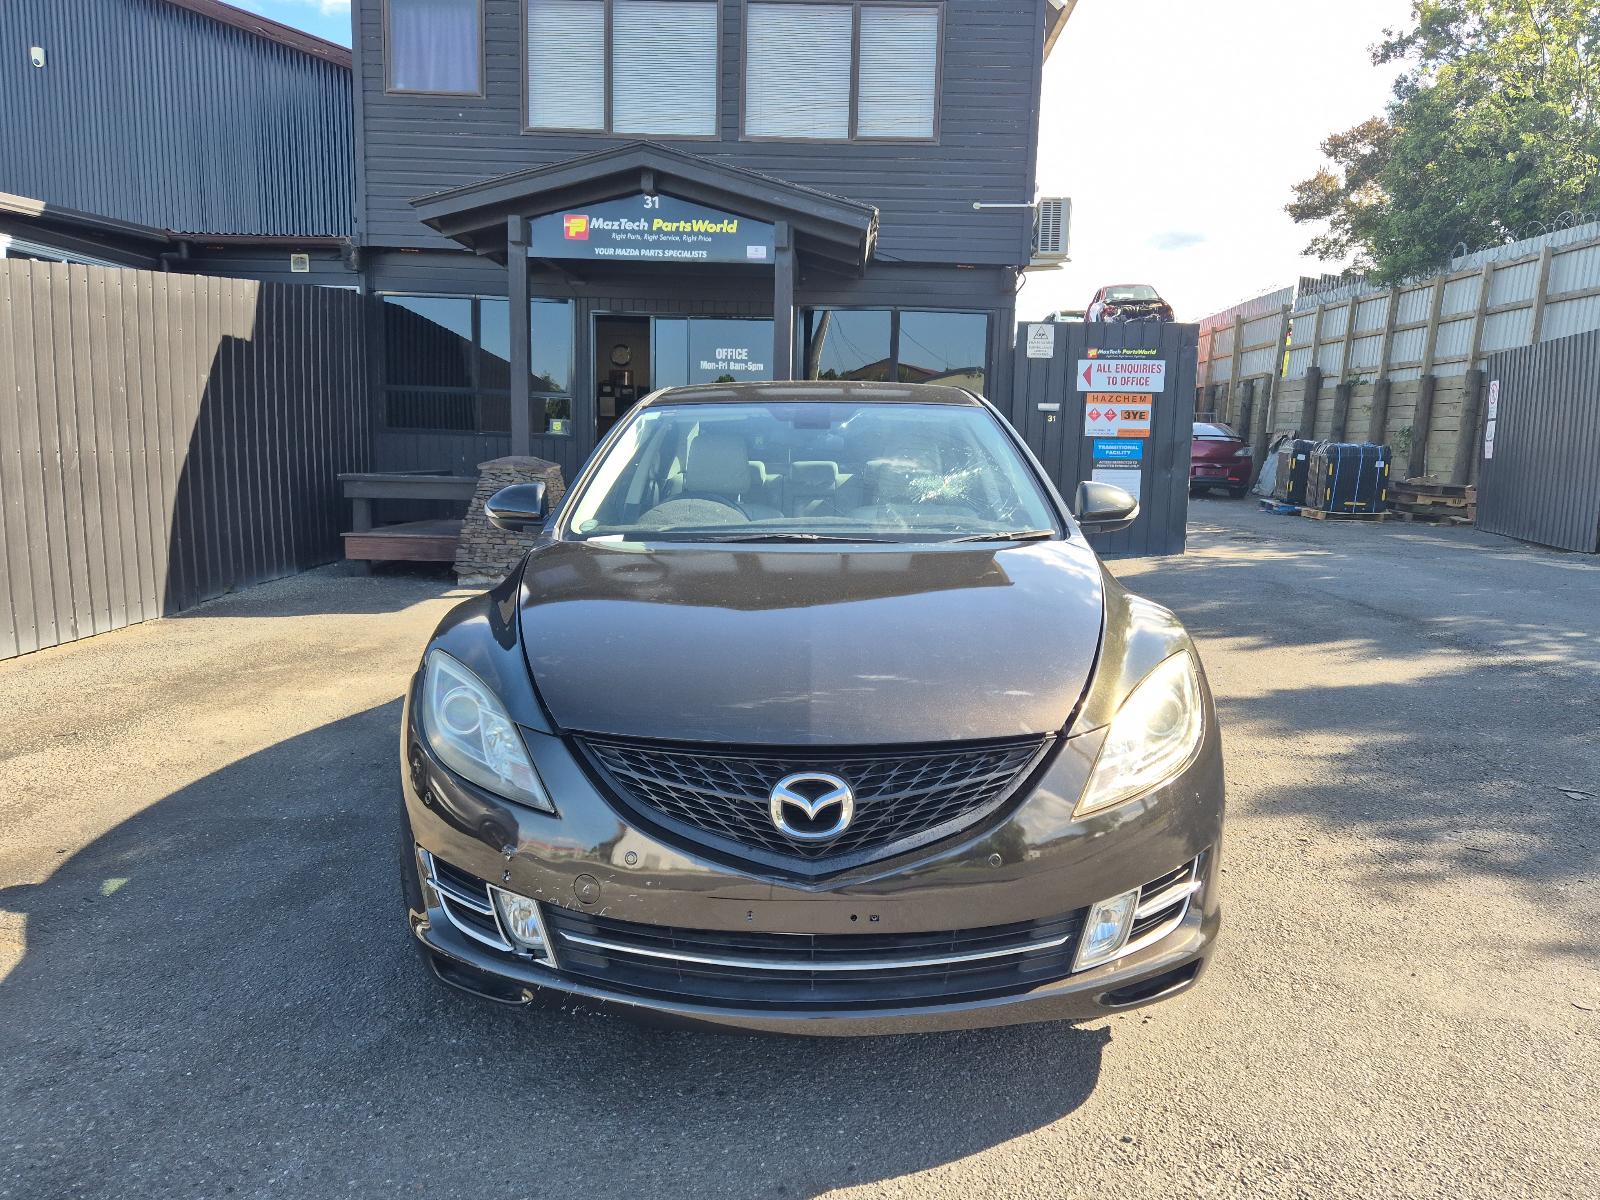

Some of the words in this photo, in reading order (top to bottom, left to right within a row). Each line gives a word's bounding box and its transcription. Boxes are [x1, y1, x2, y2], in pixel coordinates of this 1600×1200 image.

[643, 195, 659, 209] 31
[590, 217, 649, 230] MazTech
[652, 218, 738, 233] PartsWorld
[611, 232, 626, 241] Right
[643, 233, 658, 242] Right
[682, 234, 697, 243] Right
[594, 247, 614, 256] YOUR
[615, 248, 640, 256] MAZDA
[640, 248, 663, 257] PARTS
[664, 249, 708, 258] SPECIALISTS
[715, 348, 748, 360] OFFICE
[700, 360, 728, 370] Mon-Fri
[729, 361, 764, 371] 8am-5pm
[1097, 363, 1112, 373] ALL
[1115, 363, 1162, 374] ENQUIRIES
[1107, 376, 1117, 386] TO
[1121, 376, 1150, 386] OFFICE
[1092, 394, 1147, 403] HAZCHEM
[1124, 410, 1146, 420] 3YE
